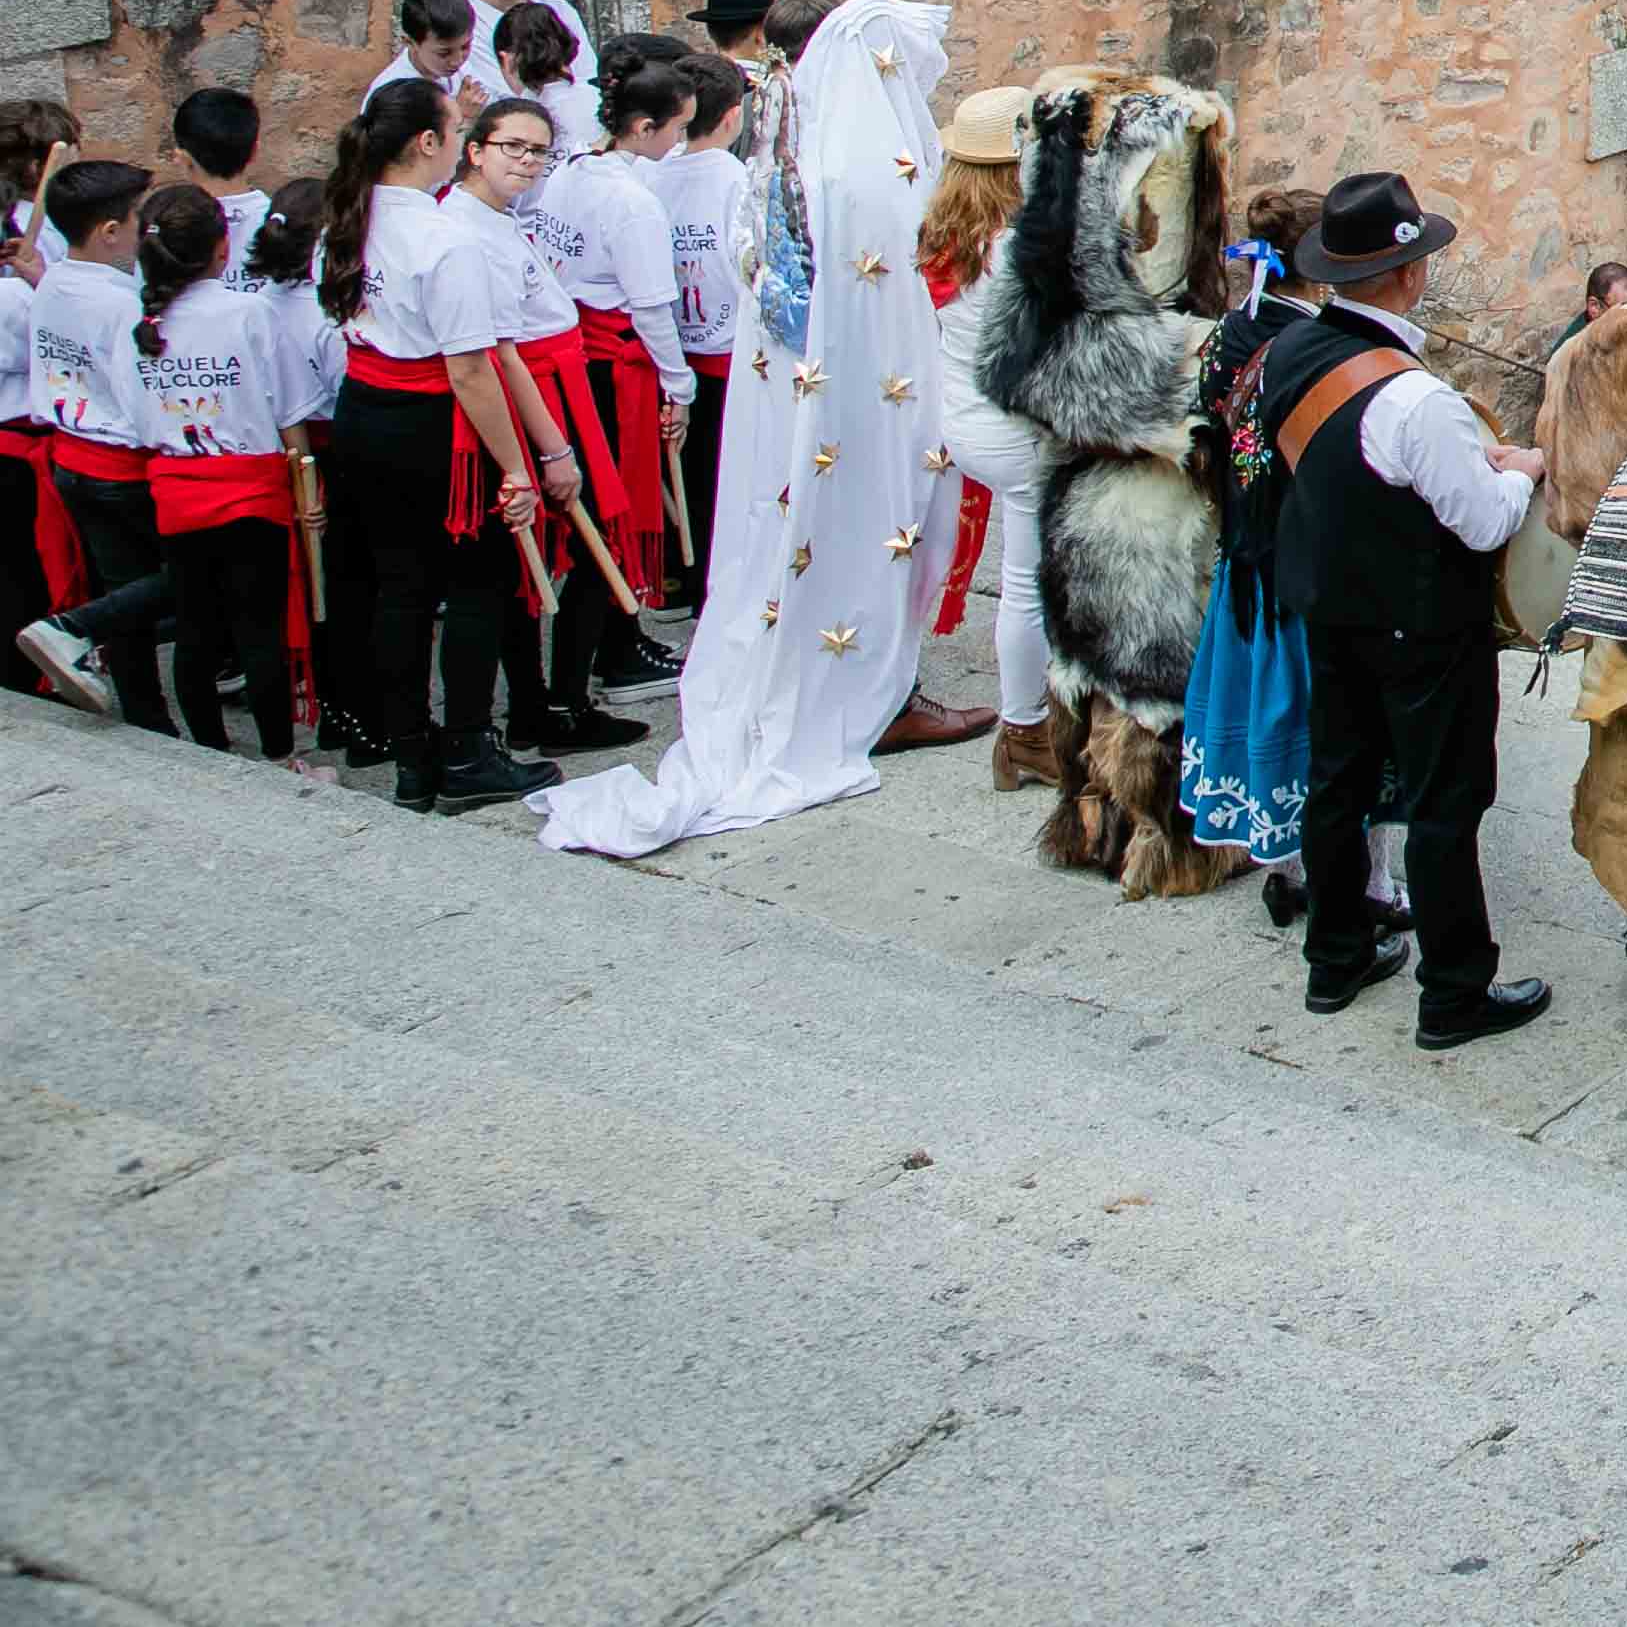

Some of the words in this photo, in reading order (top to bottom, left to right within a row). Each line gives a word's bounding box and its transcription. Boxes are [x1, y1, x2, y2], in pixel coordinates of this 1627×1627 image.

[671, 224, 717, 238] UELA
[672, 238, 719, 252] CLORE
[136, 356, 241, 374] ESCUELA
